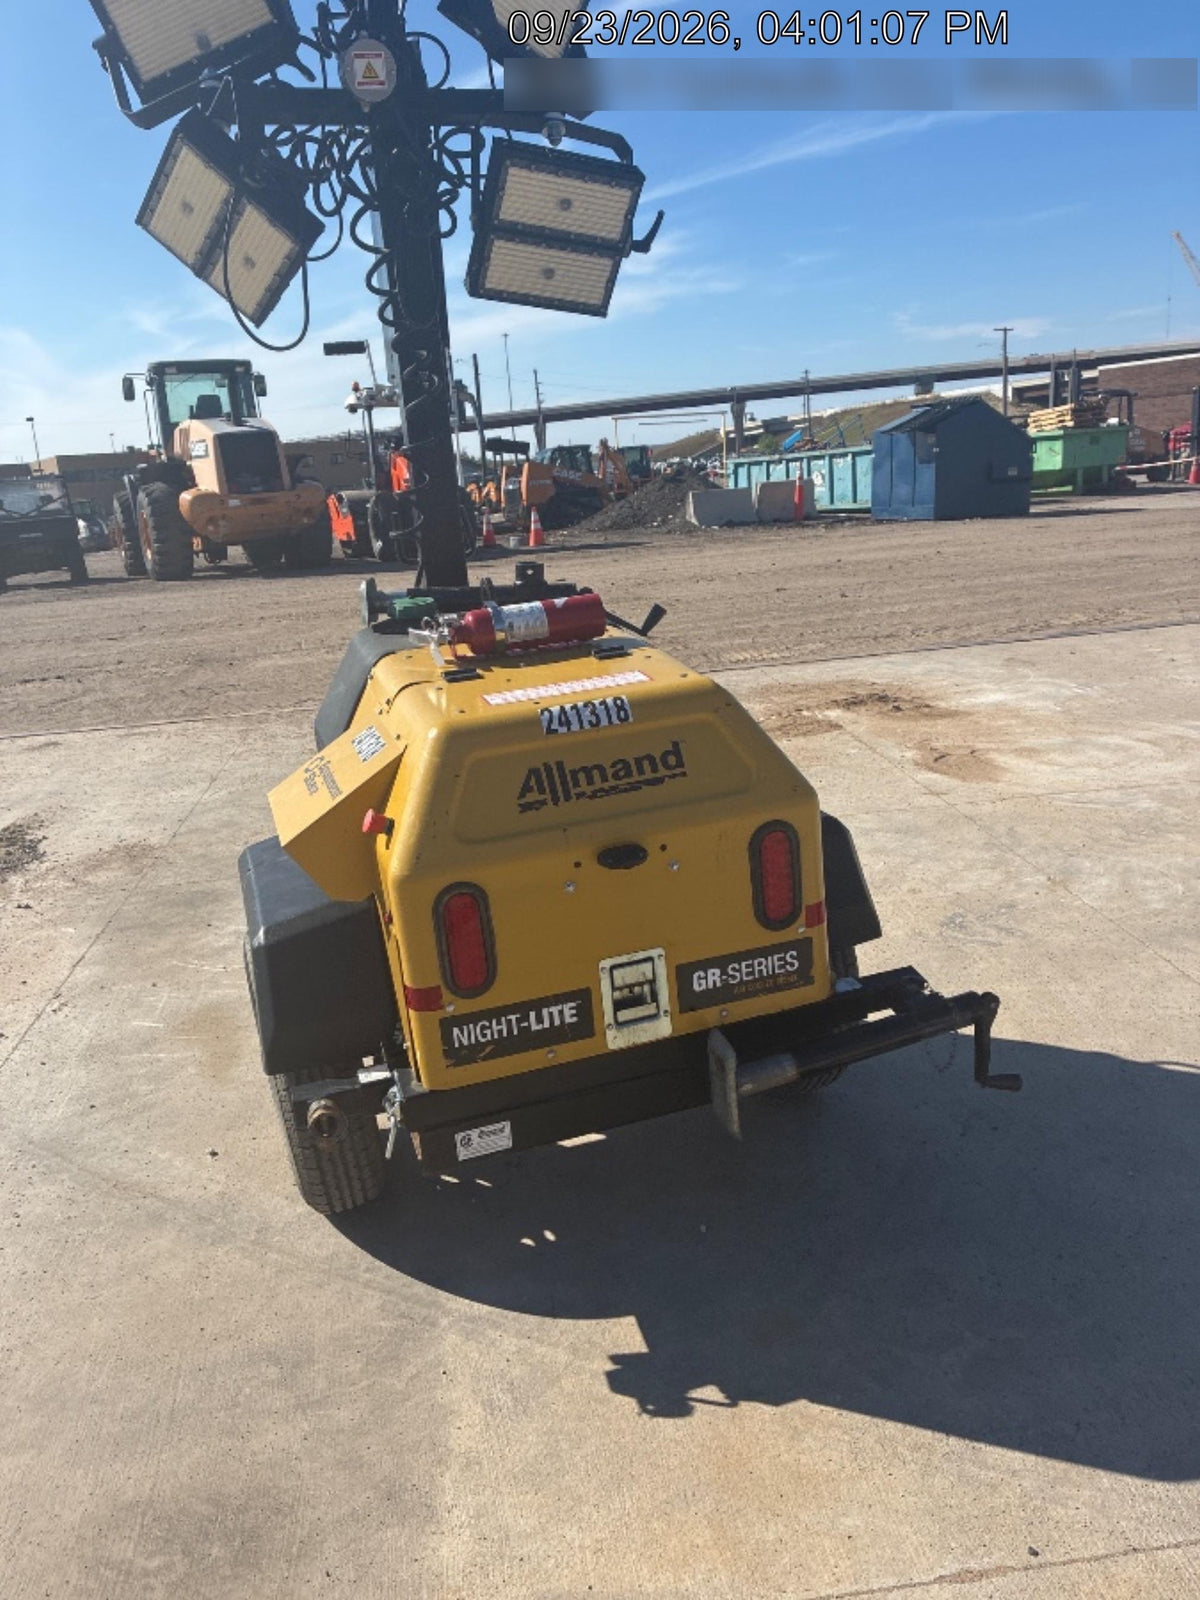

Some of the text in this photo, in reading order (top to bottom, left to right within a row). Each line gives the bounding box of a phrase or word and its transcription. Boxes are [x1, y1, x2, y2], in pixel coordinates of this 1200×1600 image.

[540, 696, 631, 736] 241318
[517, 740, 686, 806] Allmand
[692, 950, 800, 993] GR-SERIES
[452, 1001, 580, 1048] NIGHT-LITE
